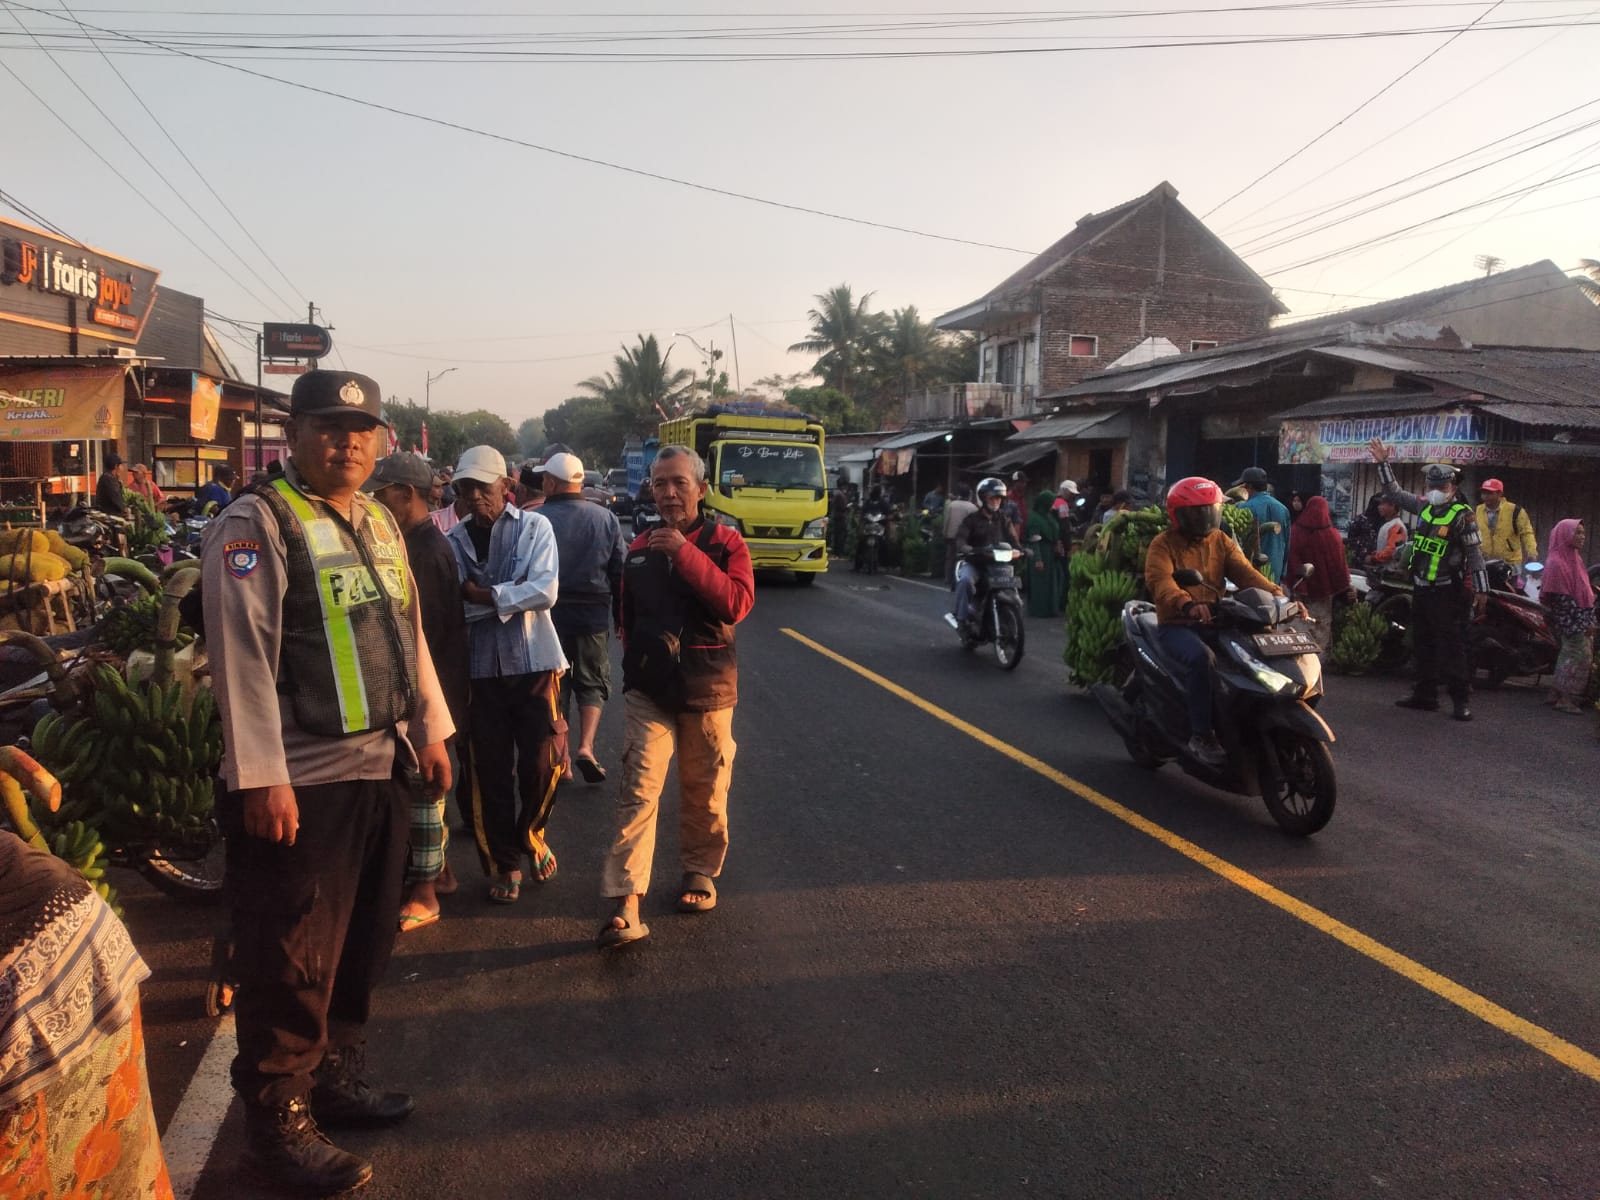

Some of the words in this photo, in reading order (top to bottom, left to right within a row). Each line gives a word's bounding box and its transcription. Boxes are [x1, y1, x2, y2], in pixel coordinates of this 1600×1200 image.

[52, 250, 98, 299] faris
[98, 268, 132, 310] jaya
[1319, 421, 1351, 444] TOKO
[1353, 418, 1393, 442] BUAH
[1394, 415, 1440, 441] LOKAL
[1443, 415, 1486, 441] DAN
[1445, 445, 1473, 459] 0823
